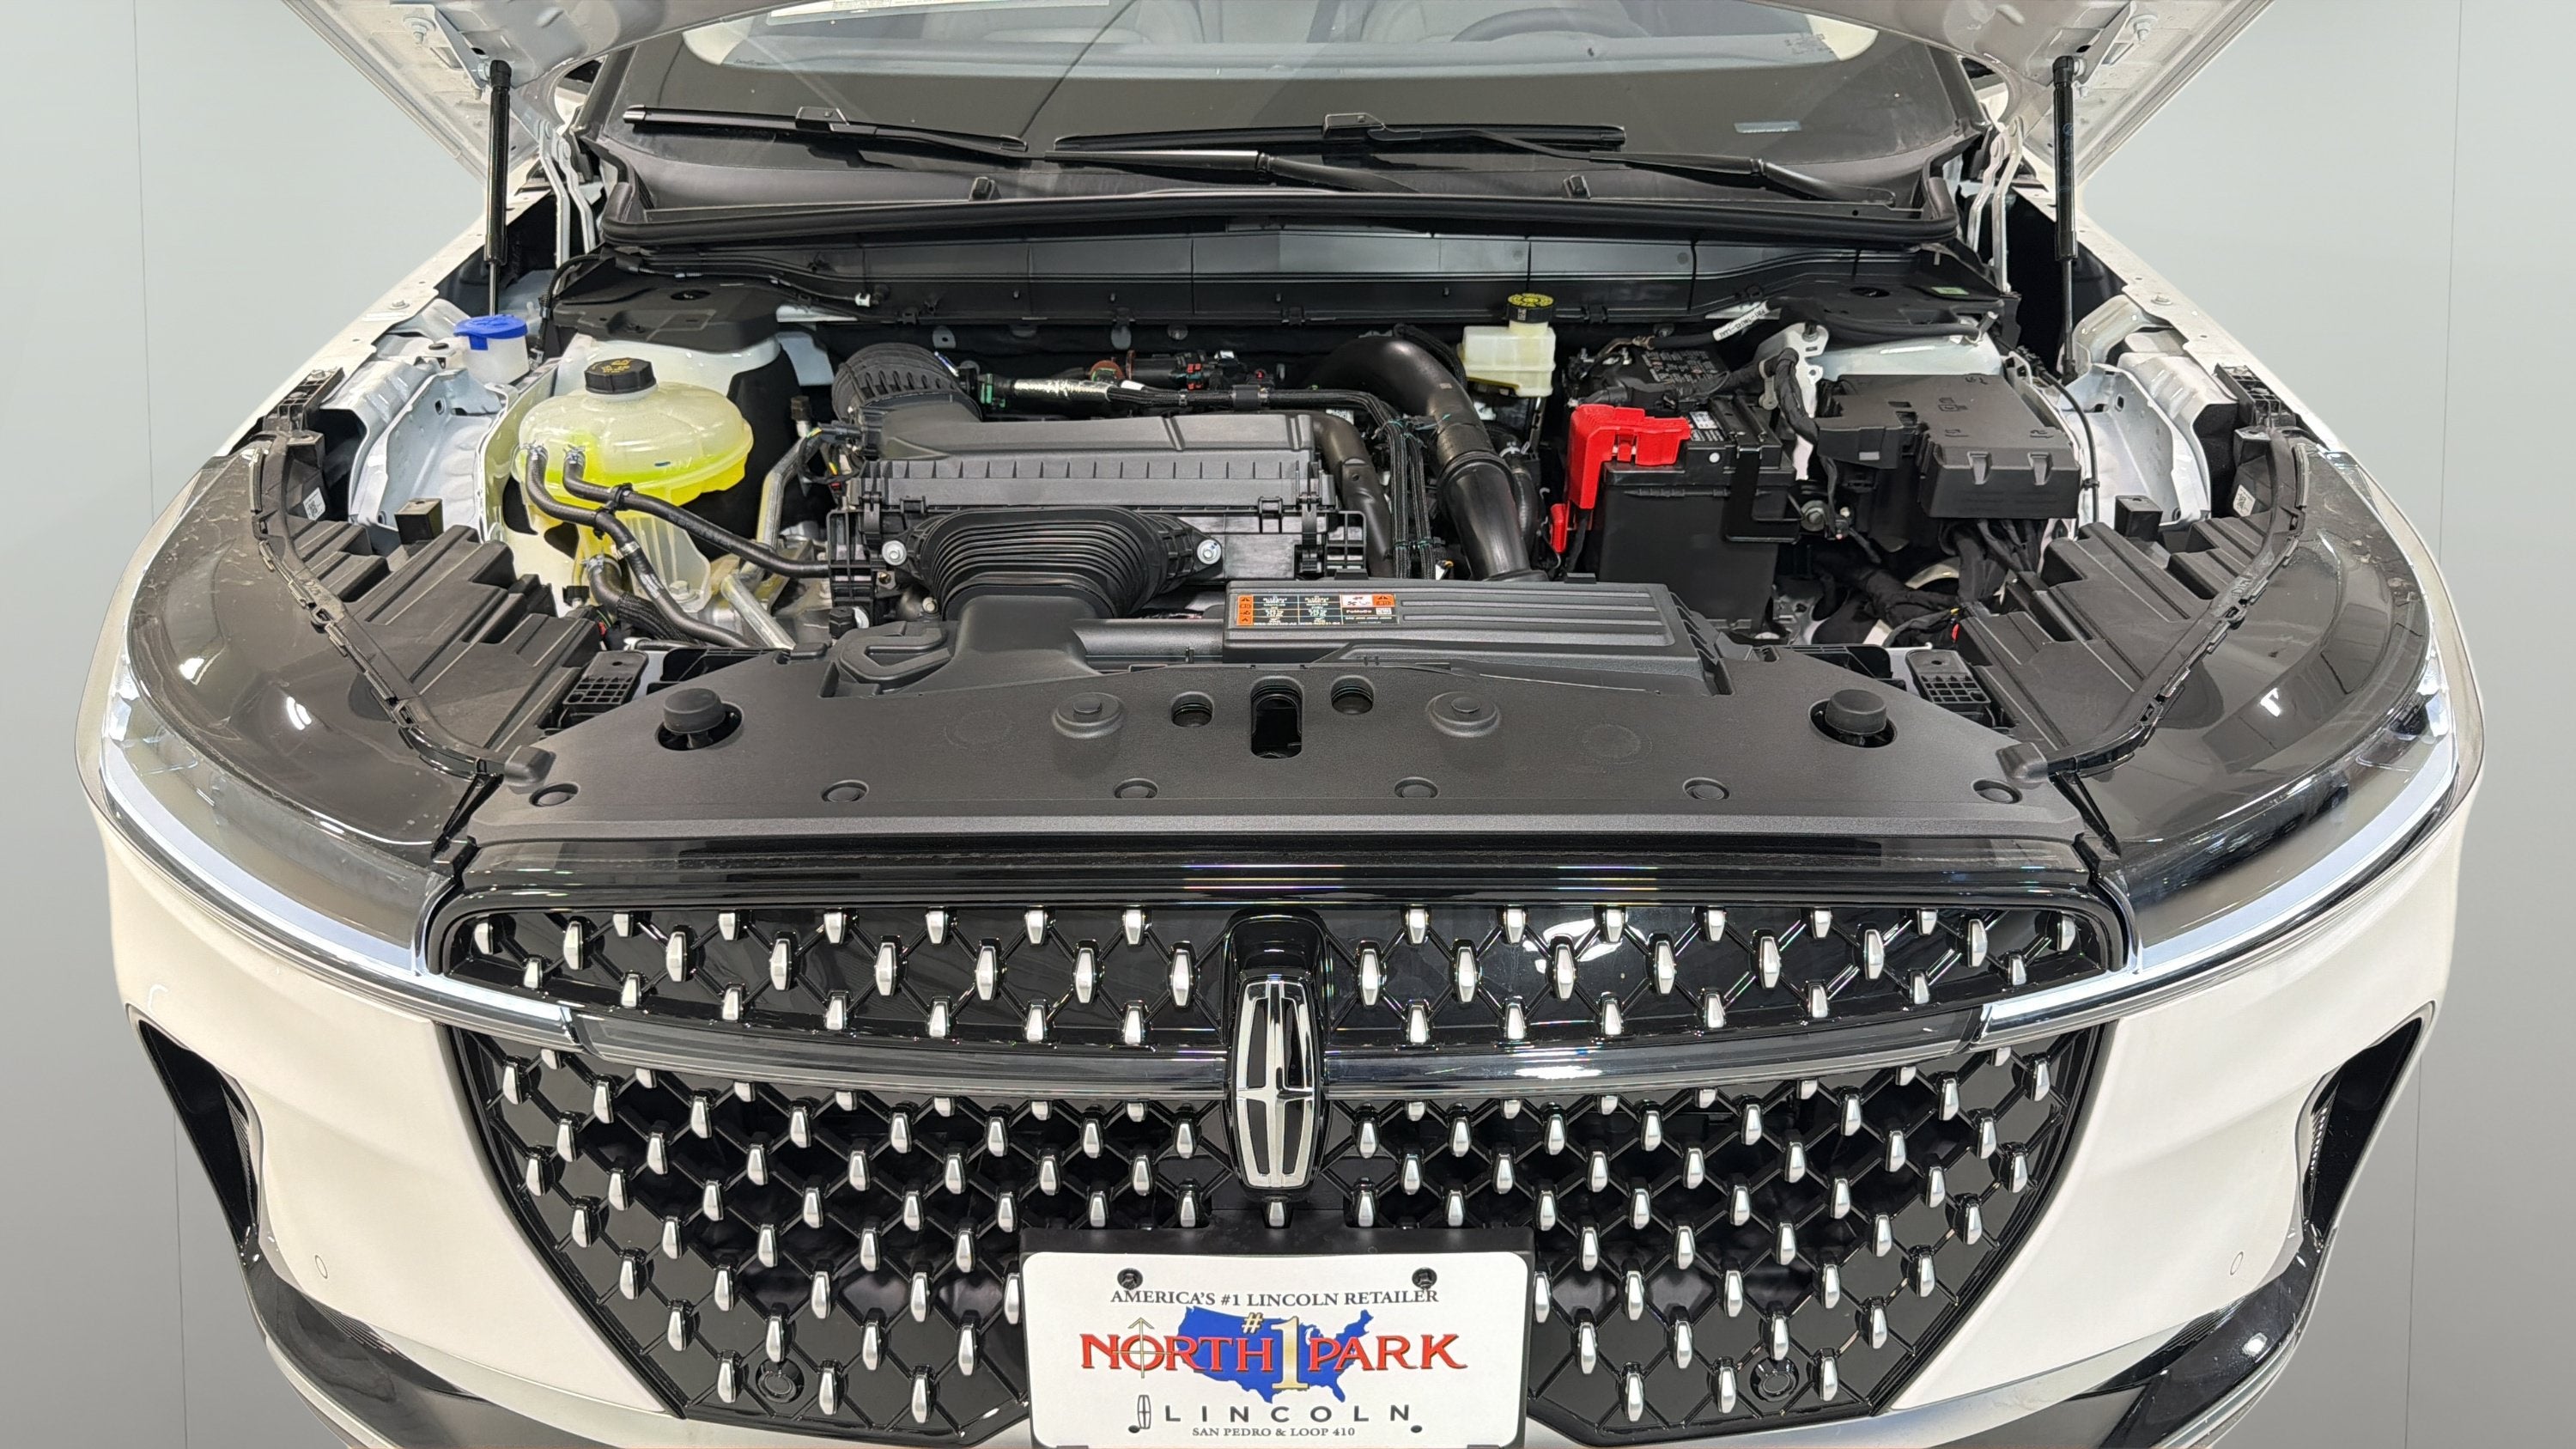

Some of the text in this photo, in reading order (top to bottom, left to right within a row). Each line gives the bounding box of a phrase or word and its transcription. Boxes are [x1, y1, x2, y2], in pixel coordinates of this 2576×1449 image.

[1111, 1290, 1439, 1306] AMERICA'S #1 LINCOLN RETAILER
[1081, 1334, 1273, 1373] NORTH
[1309, 1334, 1468, 1372] PARK
[1165, 1403, 1410, 1423] LINCOLN
[1192, 1427, 1356, 1437] SAN PEDRO & LOOP 410
